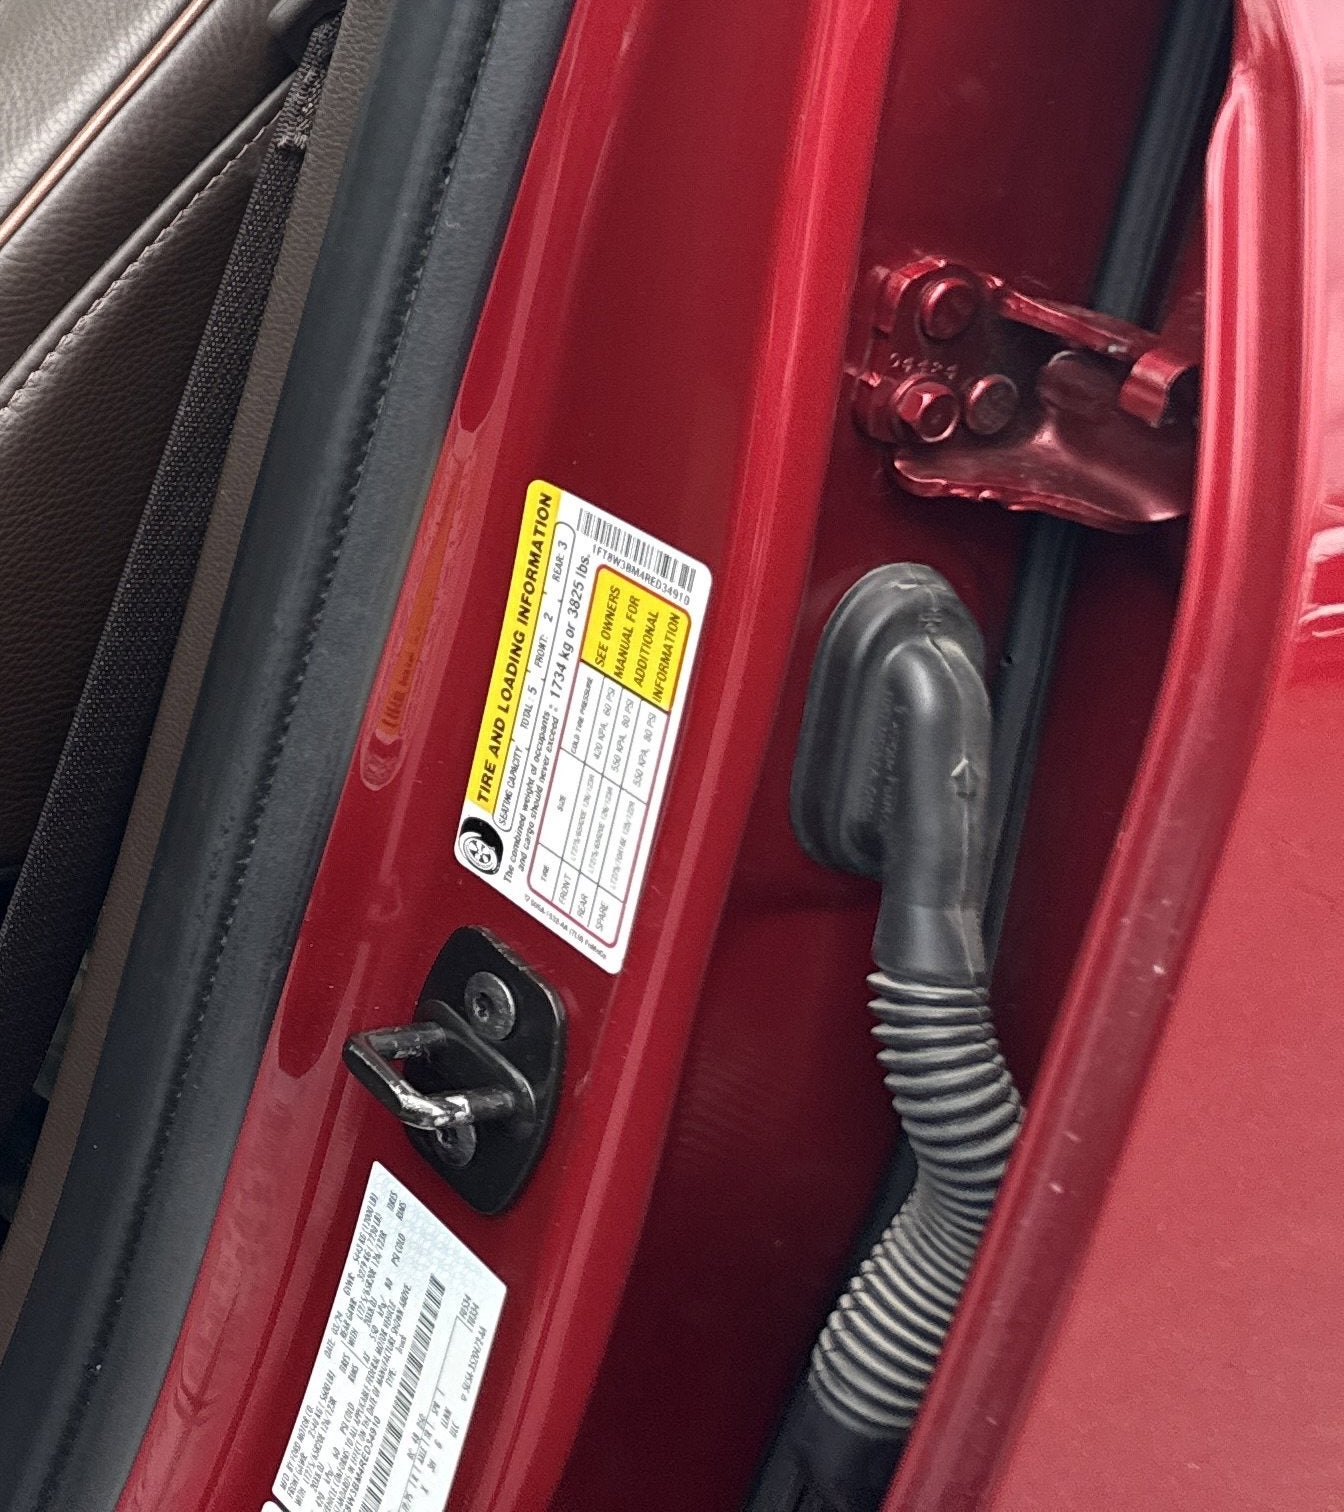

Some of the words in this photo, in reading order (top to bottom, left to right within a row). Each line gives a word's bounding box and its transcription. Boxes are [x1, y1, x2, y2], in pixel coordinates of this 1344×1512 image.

[557, 540, 568, 551] 3
[567, 579, 585, 619] 3825
[600, 585, 621, 641] OWNERS
[543, 611, 554, 623] 2
[565, 621, 576, 639] or
[476, 758, 497, 803] TIRE
[488, 716, 506, 759] AND
[501, 629, 526, 714] LOADING
[517, 492, 553, 627] INFORMATION
[558, 641, 575, 661] kg
[613, 626, 634, 680] MANUAL
[625, 594, 641, 624] FOR
[633, 611, 660, 689] ADDITIONAL
[594, 641, 609, 668] SEE
[651, 611, 681, 703] INFORMATION
[527, 684, 538, 696] 5
[549, 661, 567, 699] 1734
[605, 686, 616, 703] PSI
[579, 676, 594, 716] PRESSURE
[624, 697, 635, 715] PSI
[545, 715, 560, 754] exceed
[575, 715, 585, 733] TIRE
[646, 711, 657, 729] PSI
[533, 710, 551, 764] occupants
[570, 733, 580, 755] COLD
[530, 763, 538, 776] of
[538, 754, 550, 784] never
[498, 789, 513, 826] SEATING
[506, 745, 523, 789] CAPACITY
[521, 776, 536, 812] weight
[529, 783, 544, 821] should
[509, 812, 527, 864] combined
[522, 820, 535, 851] cargo
[503, 864, 515, 884] The
[517, 850, 528, 873] and
[540, 864, 550, 882] TIRE
[558, 872, 572, 905] FRONT
[576, 893, 589, 919] REAR
[595, 900, 609, 932] SPARE
